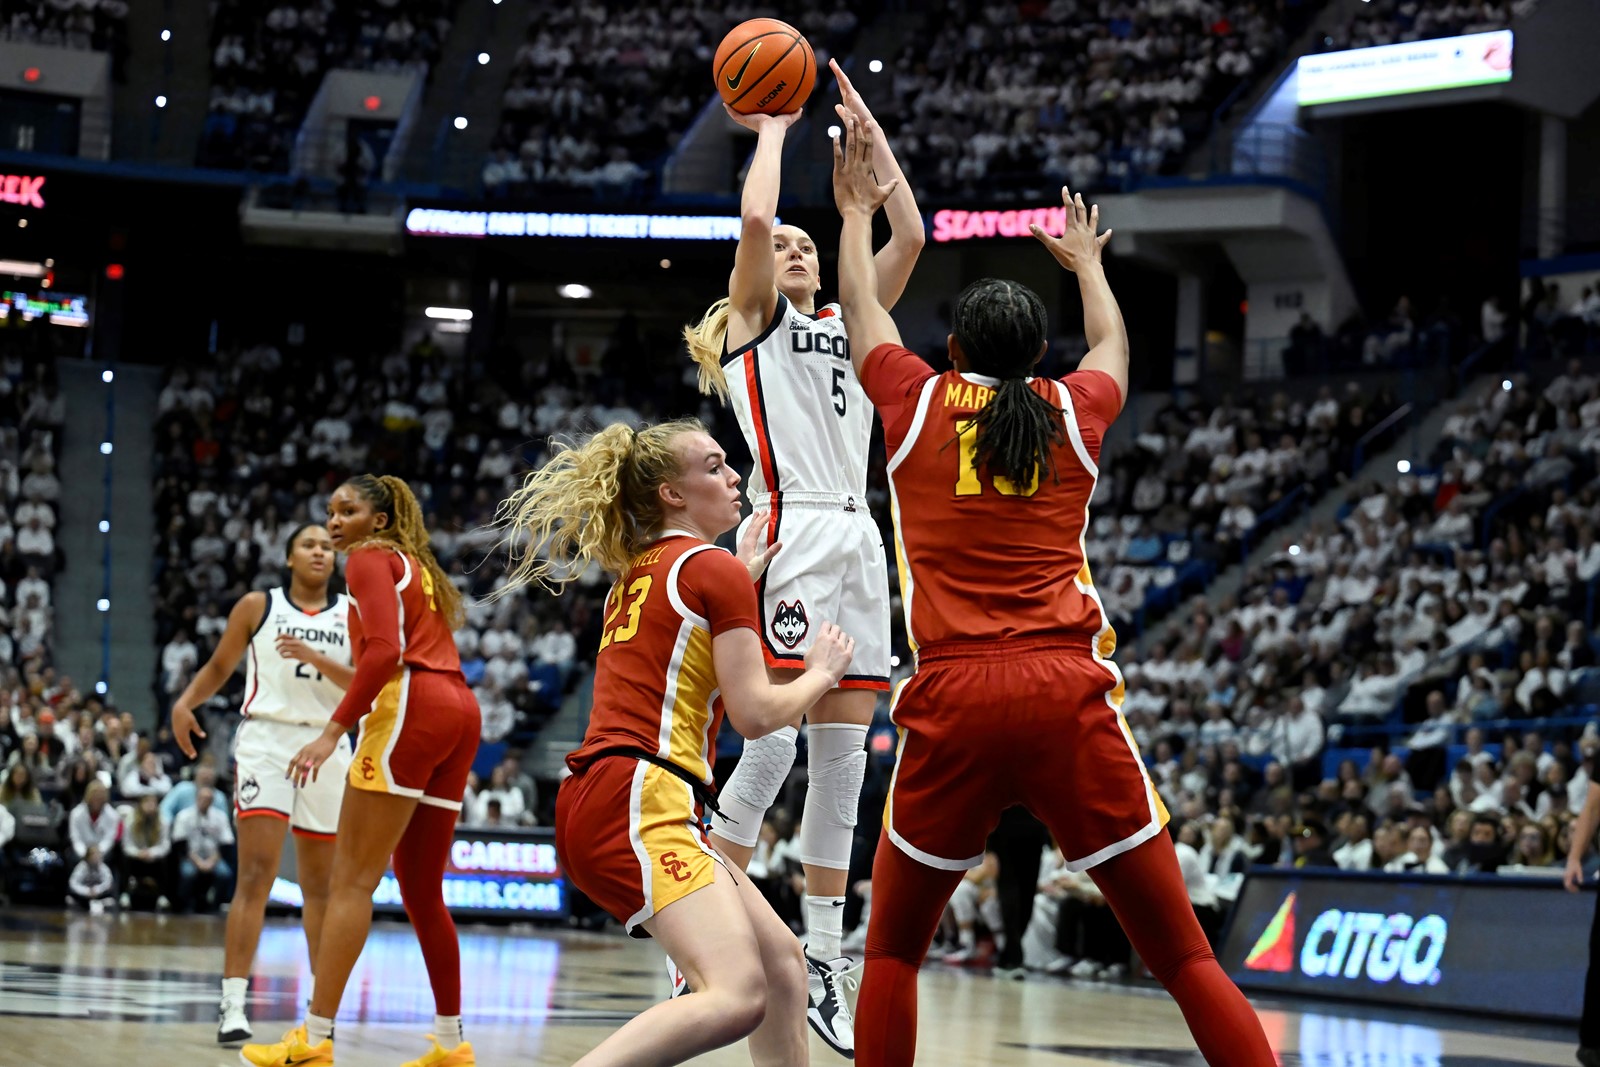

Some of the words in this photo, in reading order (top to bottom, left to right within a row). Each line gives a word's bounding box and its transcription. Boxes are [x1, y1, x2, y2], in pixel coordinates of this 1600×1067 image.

[756, 80, 788, 108] UCONN
[791, 331, 851, 361] UCO
[831, 366, 847, 417] 5
[597, 574, 653, 655] 23
[451, 839, 557, 874] CAREER
[659, 851, 692, 882] SC
[1300, 908, 1448, 985] CITGO
